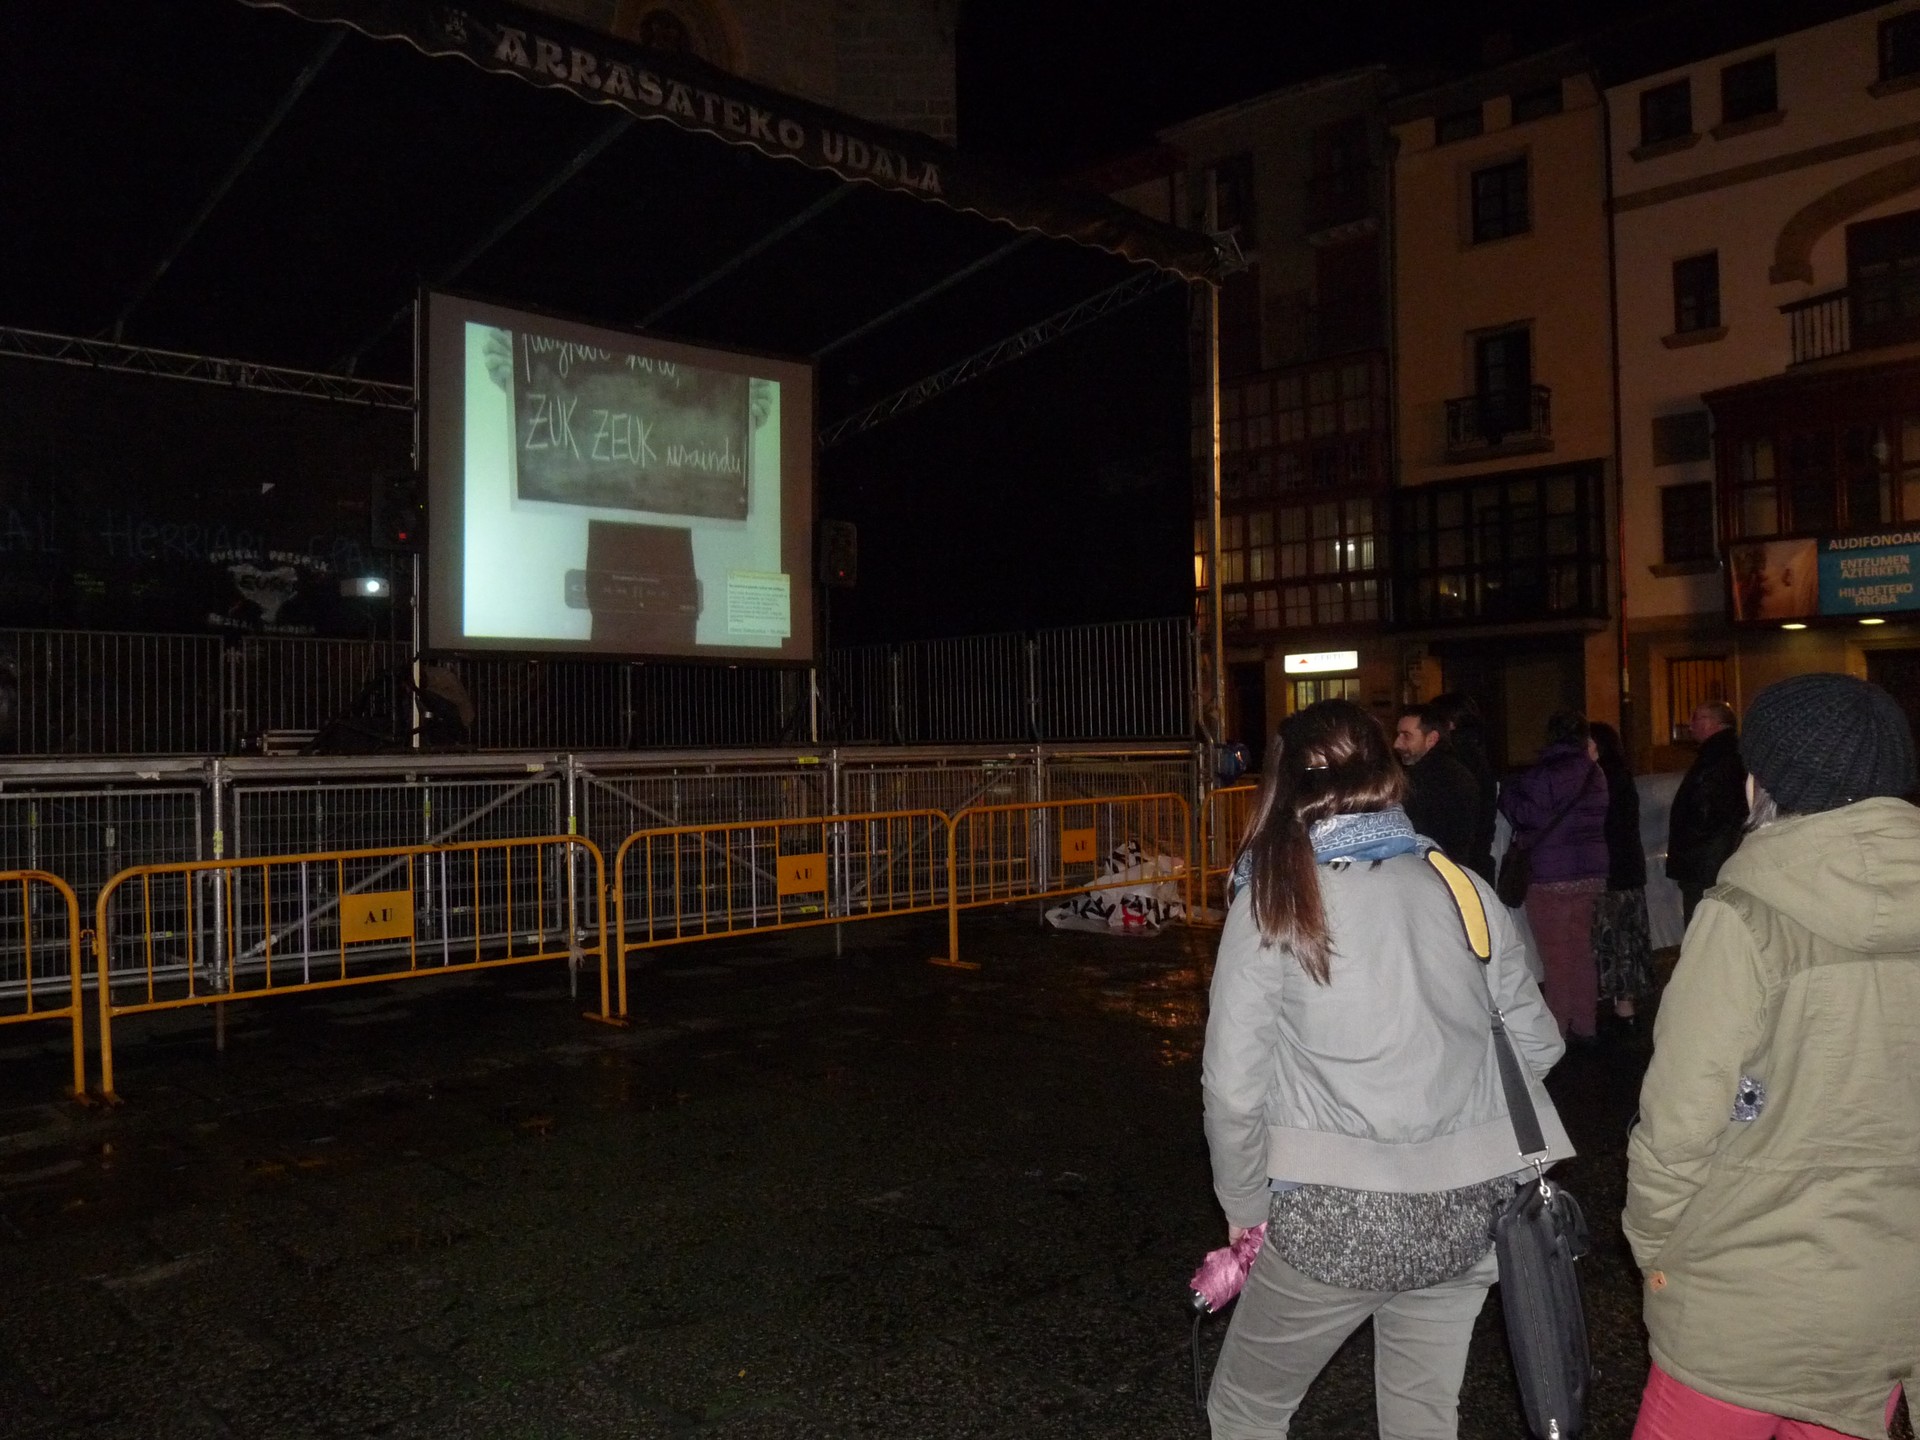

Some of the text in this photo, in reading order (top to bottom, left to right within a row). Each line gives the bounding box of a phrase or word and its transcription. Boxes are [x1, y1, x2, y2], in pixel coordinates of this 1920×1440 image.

[495, 23, 942, 194] ARRASATEKO UDALA
[526, 393, 580, 460] ZUK
[592, 409, 657, 468] ZEUK
[1829, 532, 1920, 550] AUDIFONOAK
[1841, 555, 1909, 569] ENTZUMEN
[1842, 564, 1909, 578] AZTERKETA
[1839, 583, 1913, 598] HILABETEKO
[1855, 595, 1898, 606] PROBA
